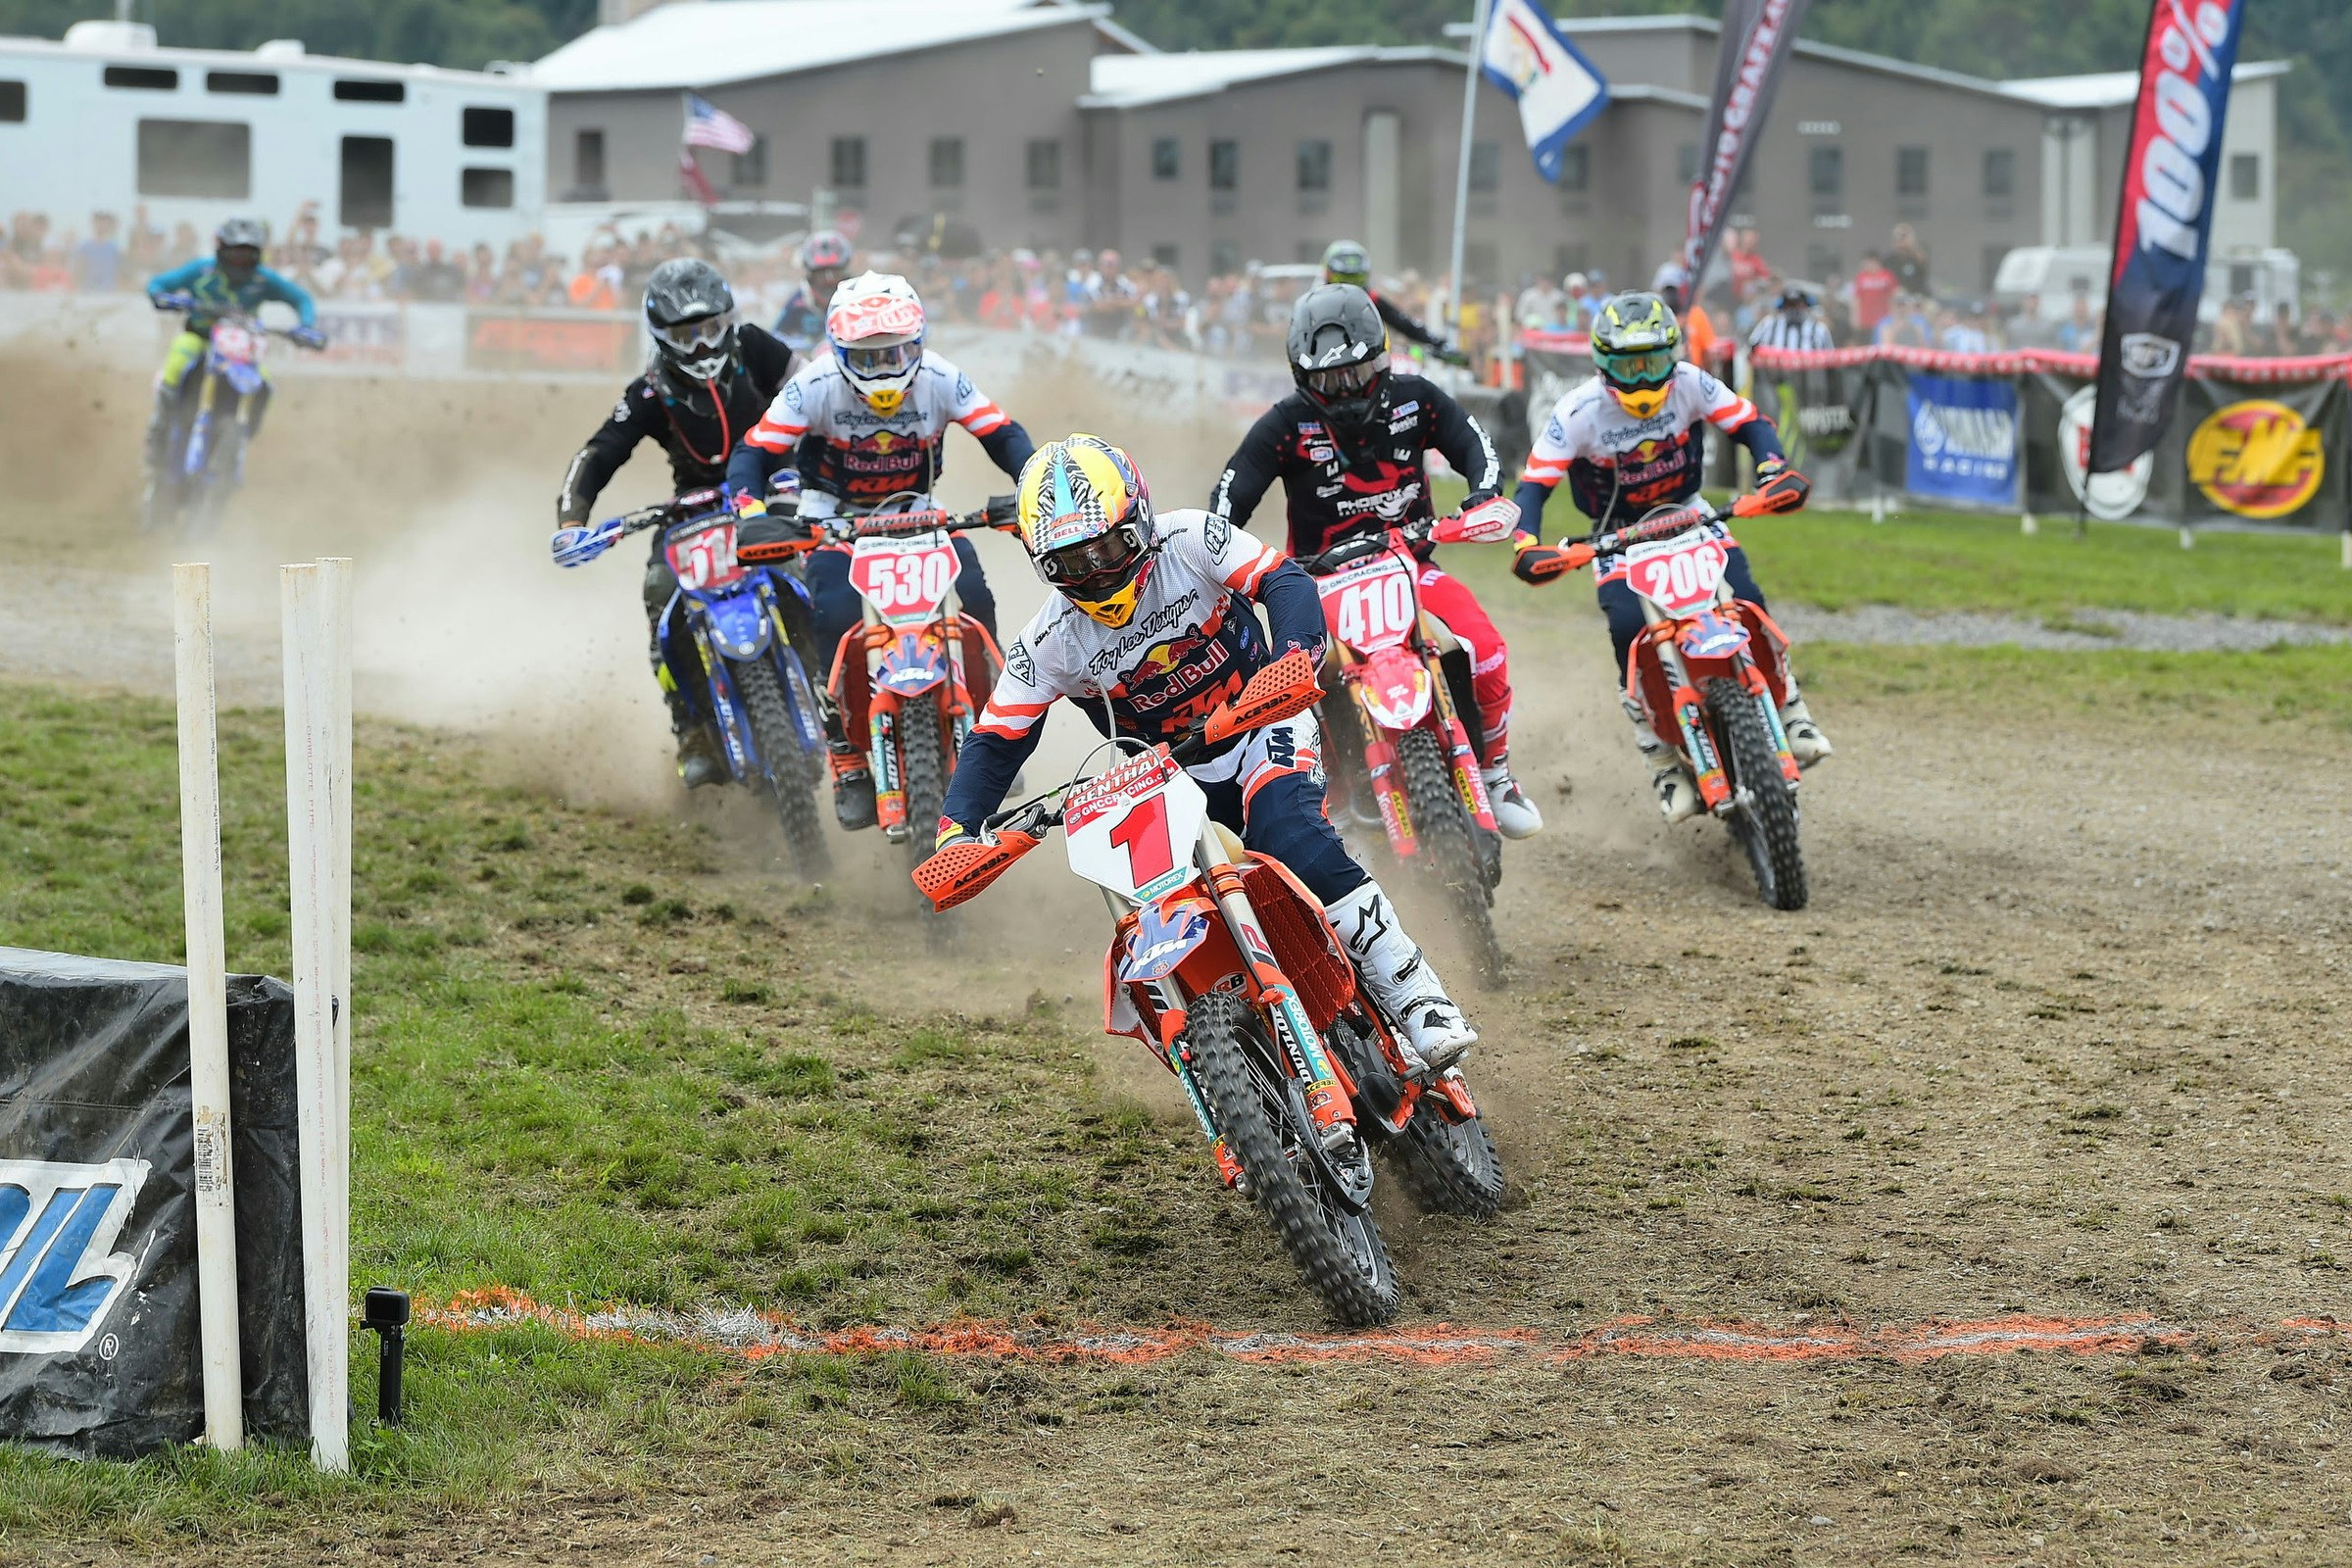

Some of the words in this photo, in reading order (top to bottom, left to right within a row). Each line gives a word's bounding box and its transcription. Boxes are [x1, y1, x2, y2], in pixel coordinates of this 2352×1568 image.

[2135, 0, 2230, 261] 100%
[844, 453, 882, 472] Red
[888, 452, 921, 471] Bull
[847, 473, 919, 493] KTM
[744, 545, 794, 558] ACERBIS
[1054, 526, 1080, 539] BELL
[868, 551, 951, 610] 530
[1645, 546, 1720, 605] 206
[1089, 648, 1119, 675] Troy
[1118, 632, 1145, 655] Lee
[1141, 589, 1198, 639] Designs
[1338, 572, 1415, 646] 410
[1128, 672, 1186, 713] Red
[1177, 638, 1230, 688] Bull
[1161, 669, 1244, 733] KTM
[1233, 693, 1293, 726] ACERBIS
[1687, 704, 1718, 769] DNLOP
[881, 713, 900, 790] DNLOP
[1266, 727, 1295, 768] KTM
[1081, 765, 1176, 816] GNCCRACING.CM
[1110, 792, 1174, 889] 1
[954, 852, 1009, 890] ACERBIS
[1151, 871, 1183, 895] MOTOREX
[1133, 939, 1188, 975] KTM
[1275, 1006, 1313, 1086] DUNLOP
[1286, 995, 1323, 1058] MOTOREX
[1179, 1071, 1214, 1143] MOTOREX
